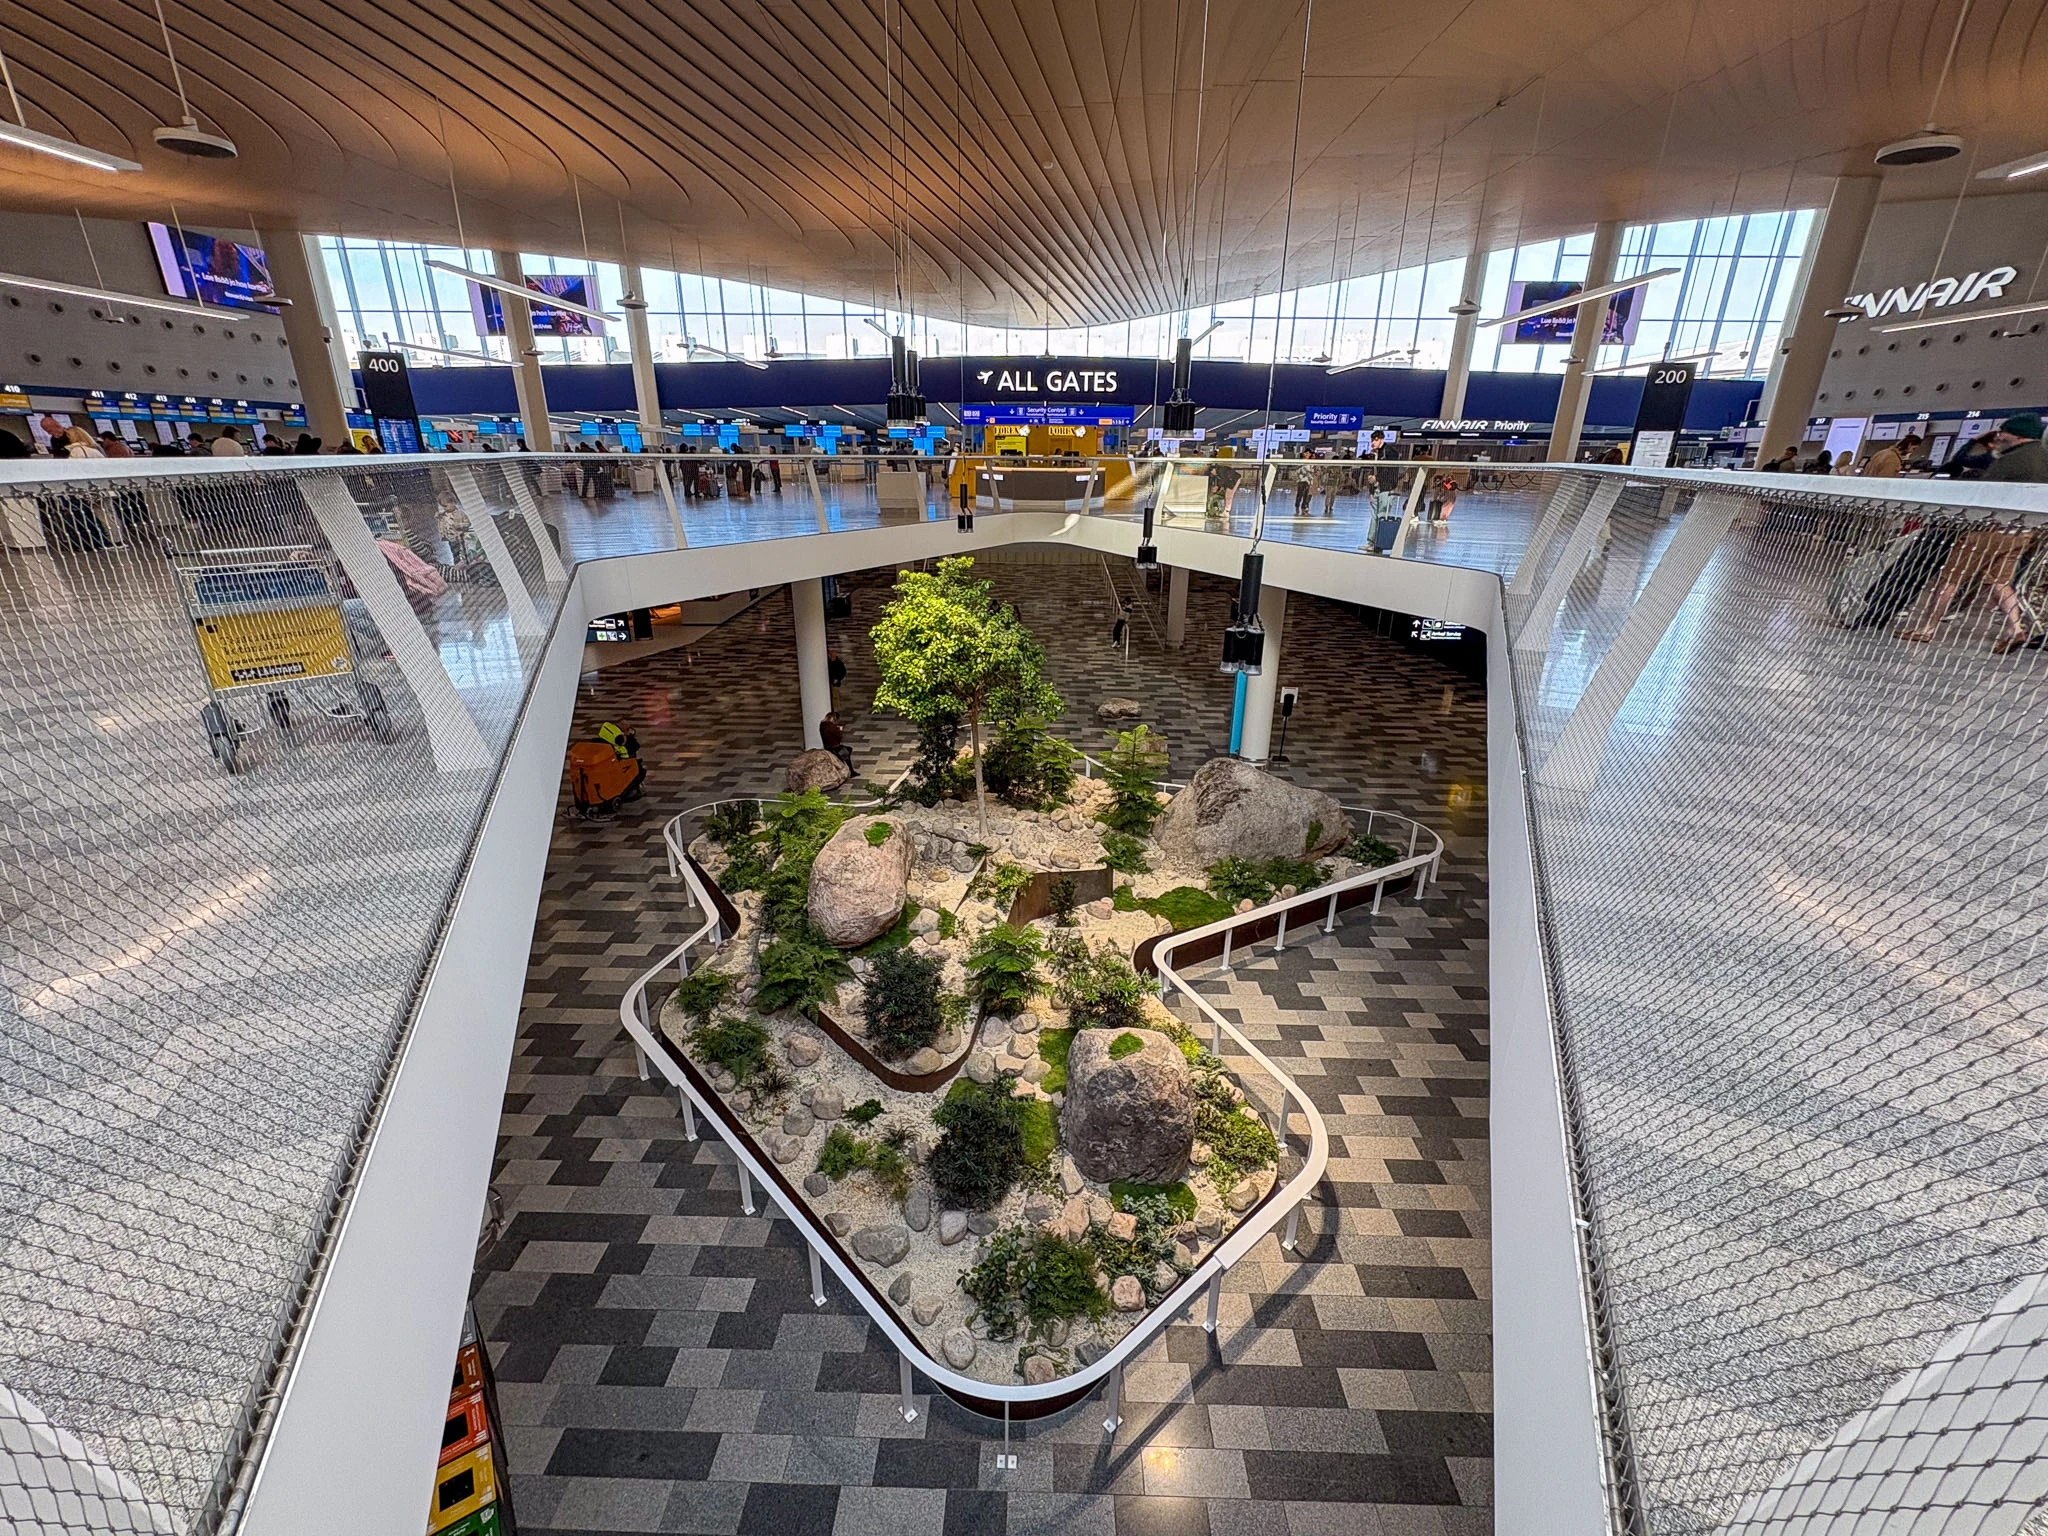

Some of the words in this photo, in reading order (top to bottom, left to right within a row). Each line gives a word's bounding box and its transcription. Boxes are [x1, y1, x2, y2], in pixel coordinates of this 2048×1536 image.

[368, 358, 399, 374] 400
[998, 372, 1038, 391] ALL
[1047, 371, 1117, 392] GATES
[1655, 369, 1687, 385] 200
[5, 385, 21, 393] 410
[1026, 406, 1046, 414] Security
[1047, 406, 1067, 414] Control
[1967, 410, 1981, 418] 214
[1313, 413, 1338, 422] Priority
[1422, 420, 1488, 429] FINNAIR
[1495, 421, 1530, 432] Priority
